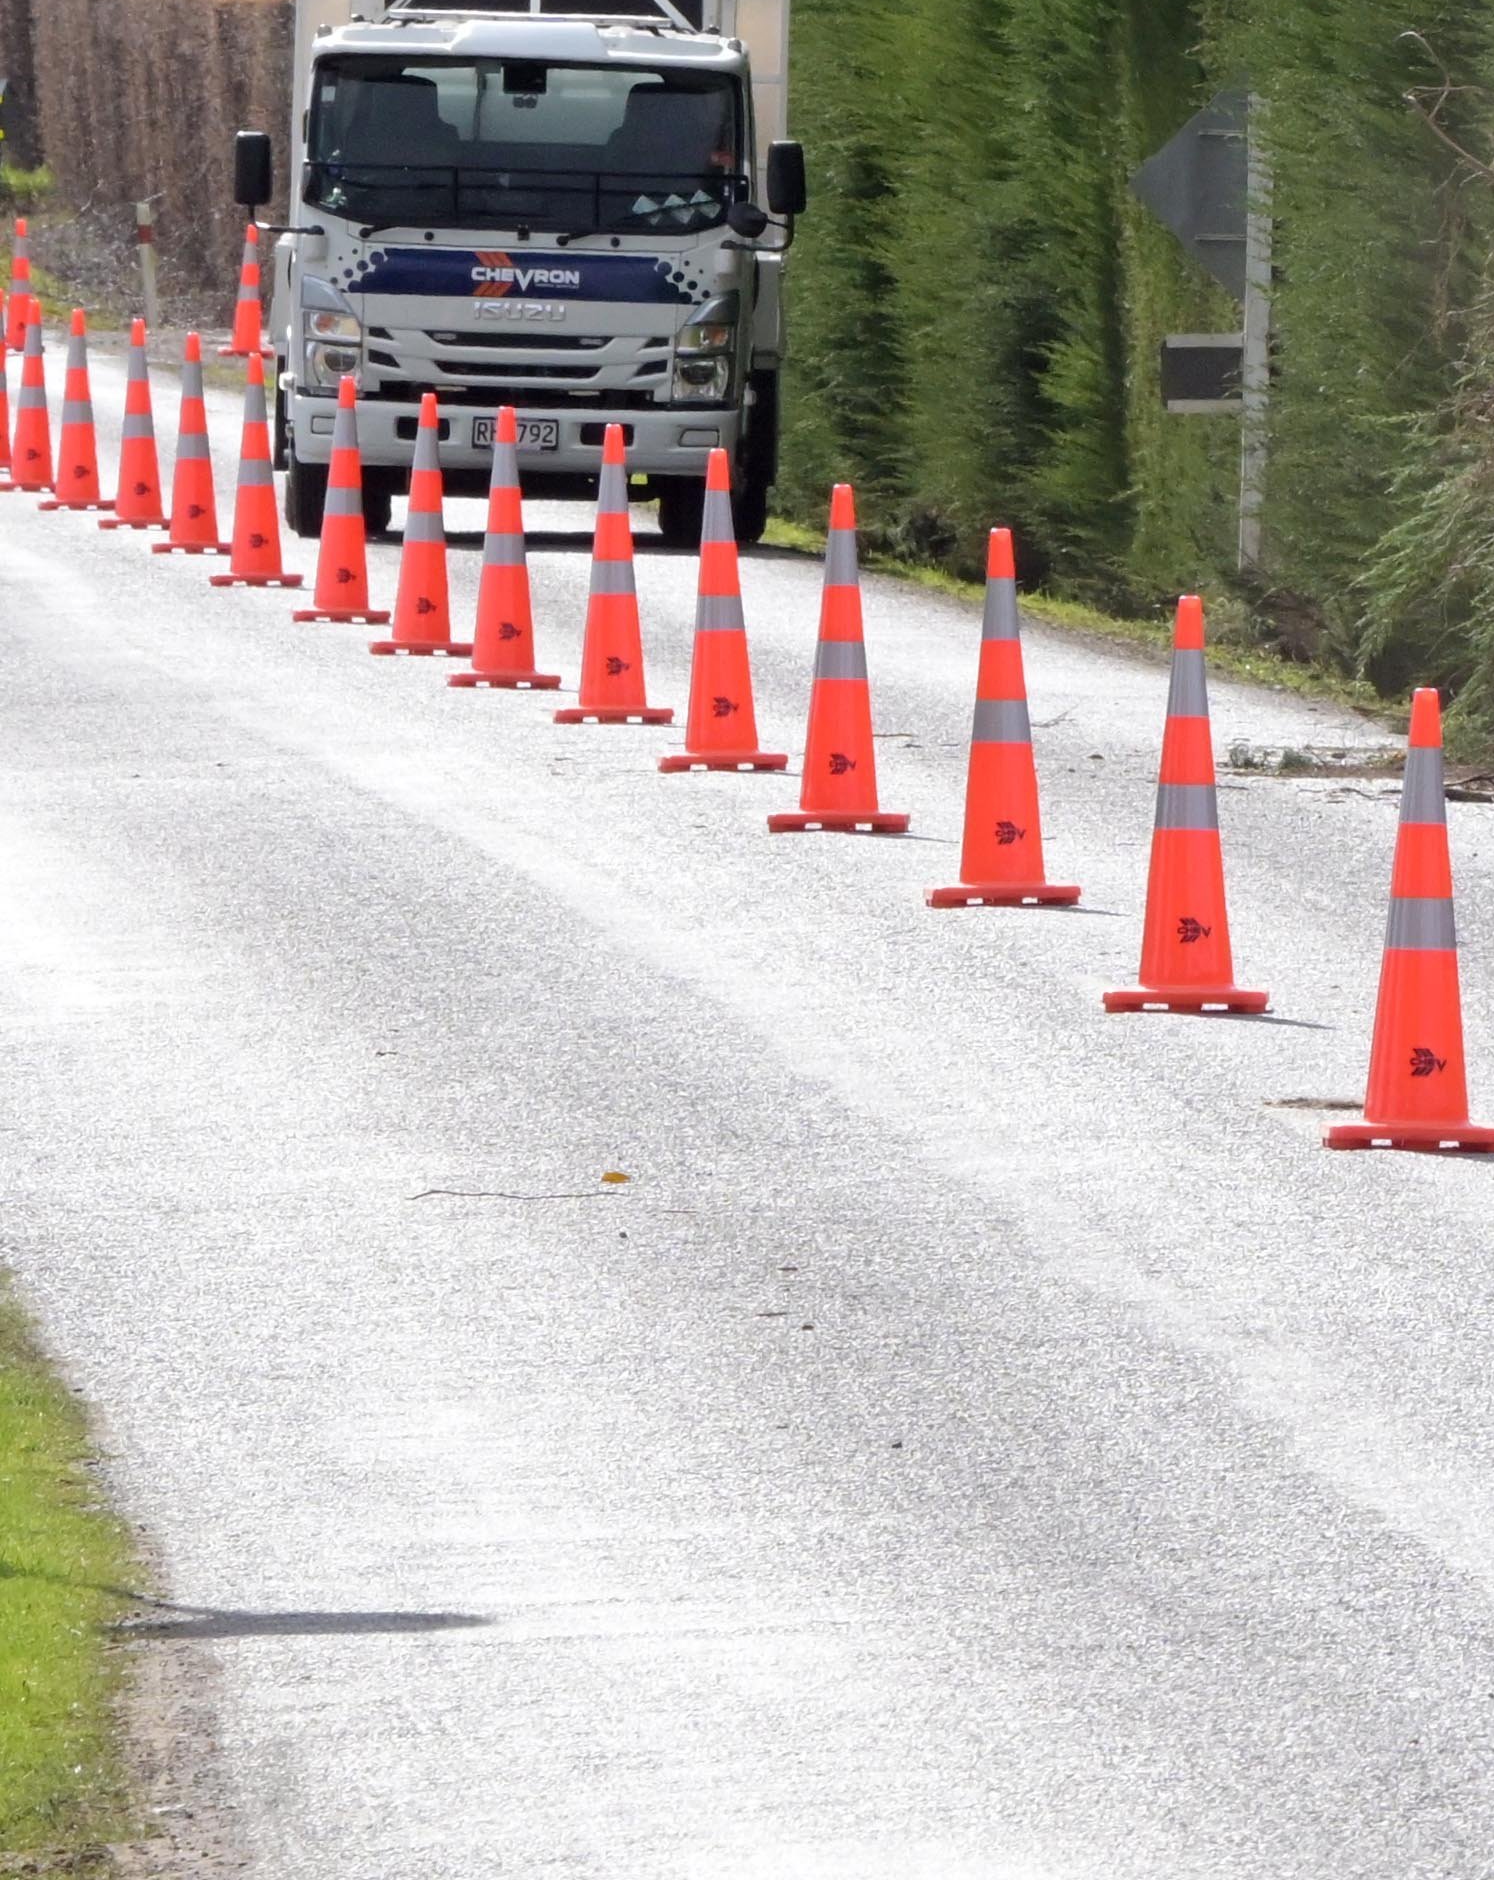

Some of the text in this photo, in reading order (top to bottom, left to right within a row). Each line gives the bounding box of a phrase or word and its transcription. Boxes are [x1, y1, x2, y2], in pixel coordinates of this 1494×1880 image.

[471, 266, 580, 292] CHEVRON
[473, 301, 566, 321] ISUZU
[476, 422, 555, 444] RH792
